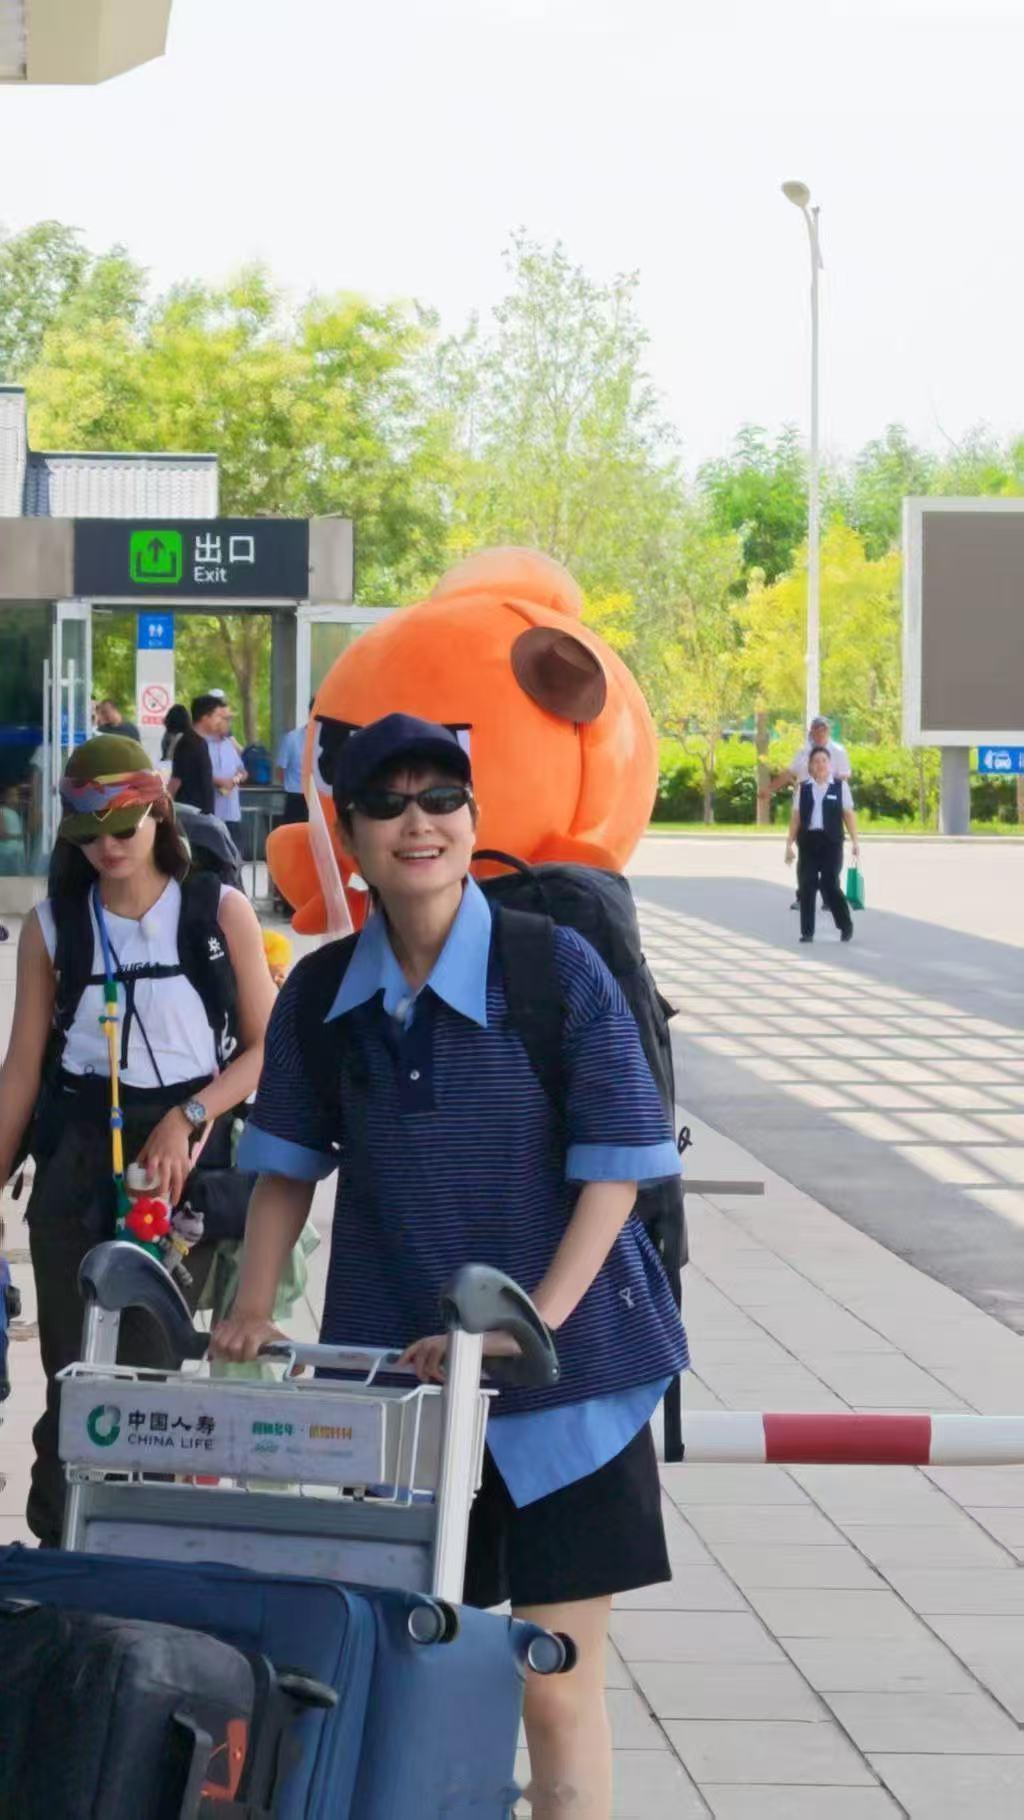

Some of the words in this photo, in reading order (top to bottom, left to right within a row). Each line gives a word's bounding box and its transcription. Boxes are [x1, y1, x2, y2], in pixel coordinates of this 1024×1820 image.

[194, 532, 254, 563] 出口
[193, 566, 227, 582] Exit
[128, 1409, 216, 1435] 中国人寿
[127, 1433, 175, 1448] CHINA
[180, 1436, 214, 1450] LIFE
